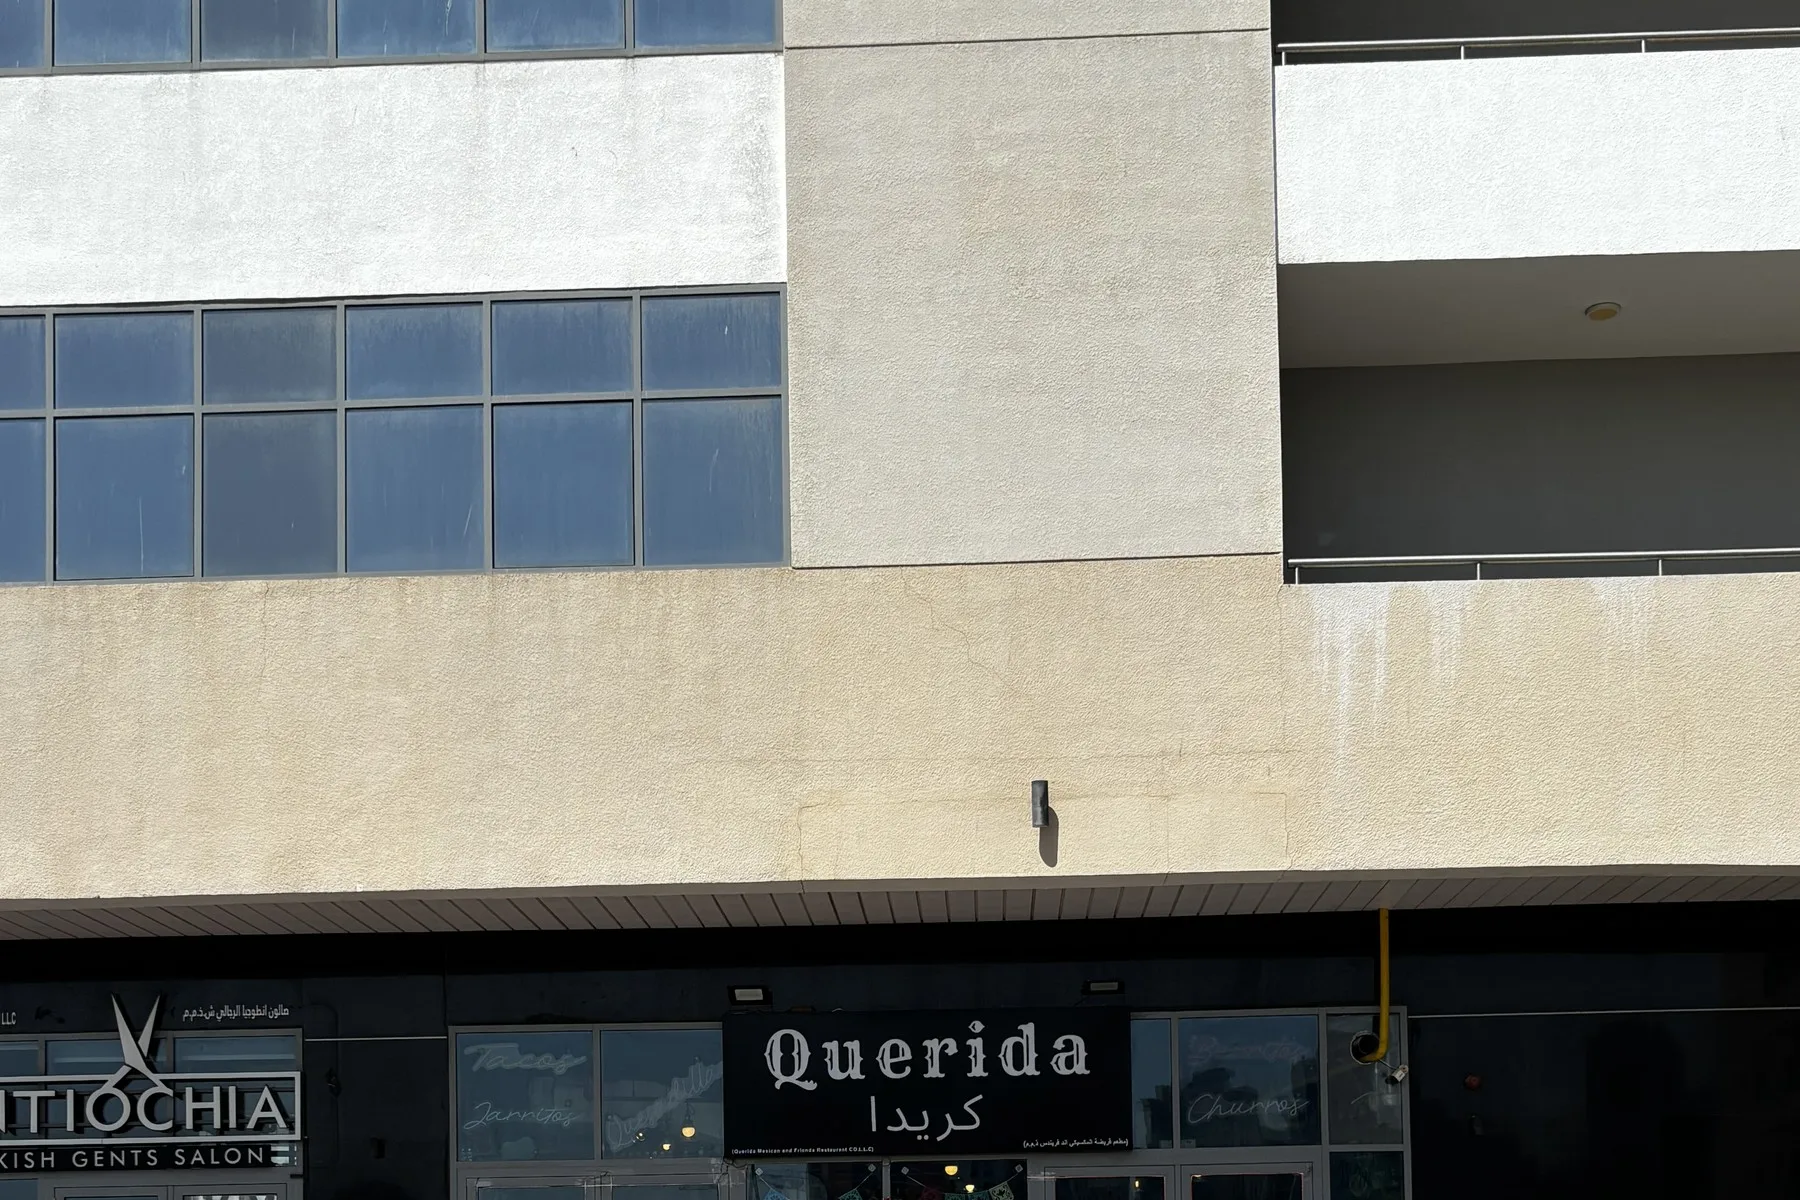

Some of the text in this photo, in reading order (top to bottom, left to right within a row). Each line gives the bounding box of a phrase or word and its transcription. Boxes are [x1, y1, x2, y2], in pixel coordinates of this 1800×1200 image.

[464, 1043, 587, 1075] Tacos
[764, 1020, 1091, 1091] Querida
[870, 1094, 983, 1142] كريدا
[1187, 1093, 1311, 1124] Churros
[72, 1149, 158, 1168] GENTS
[174, 1147, 263, 1166] SALON
